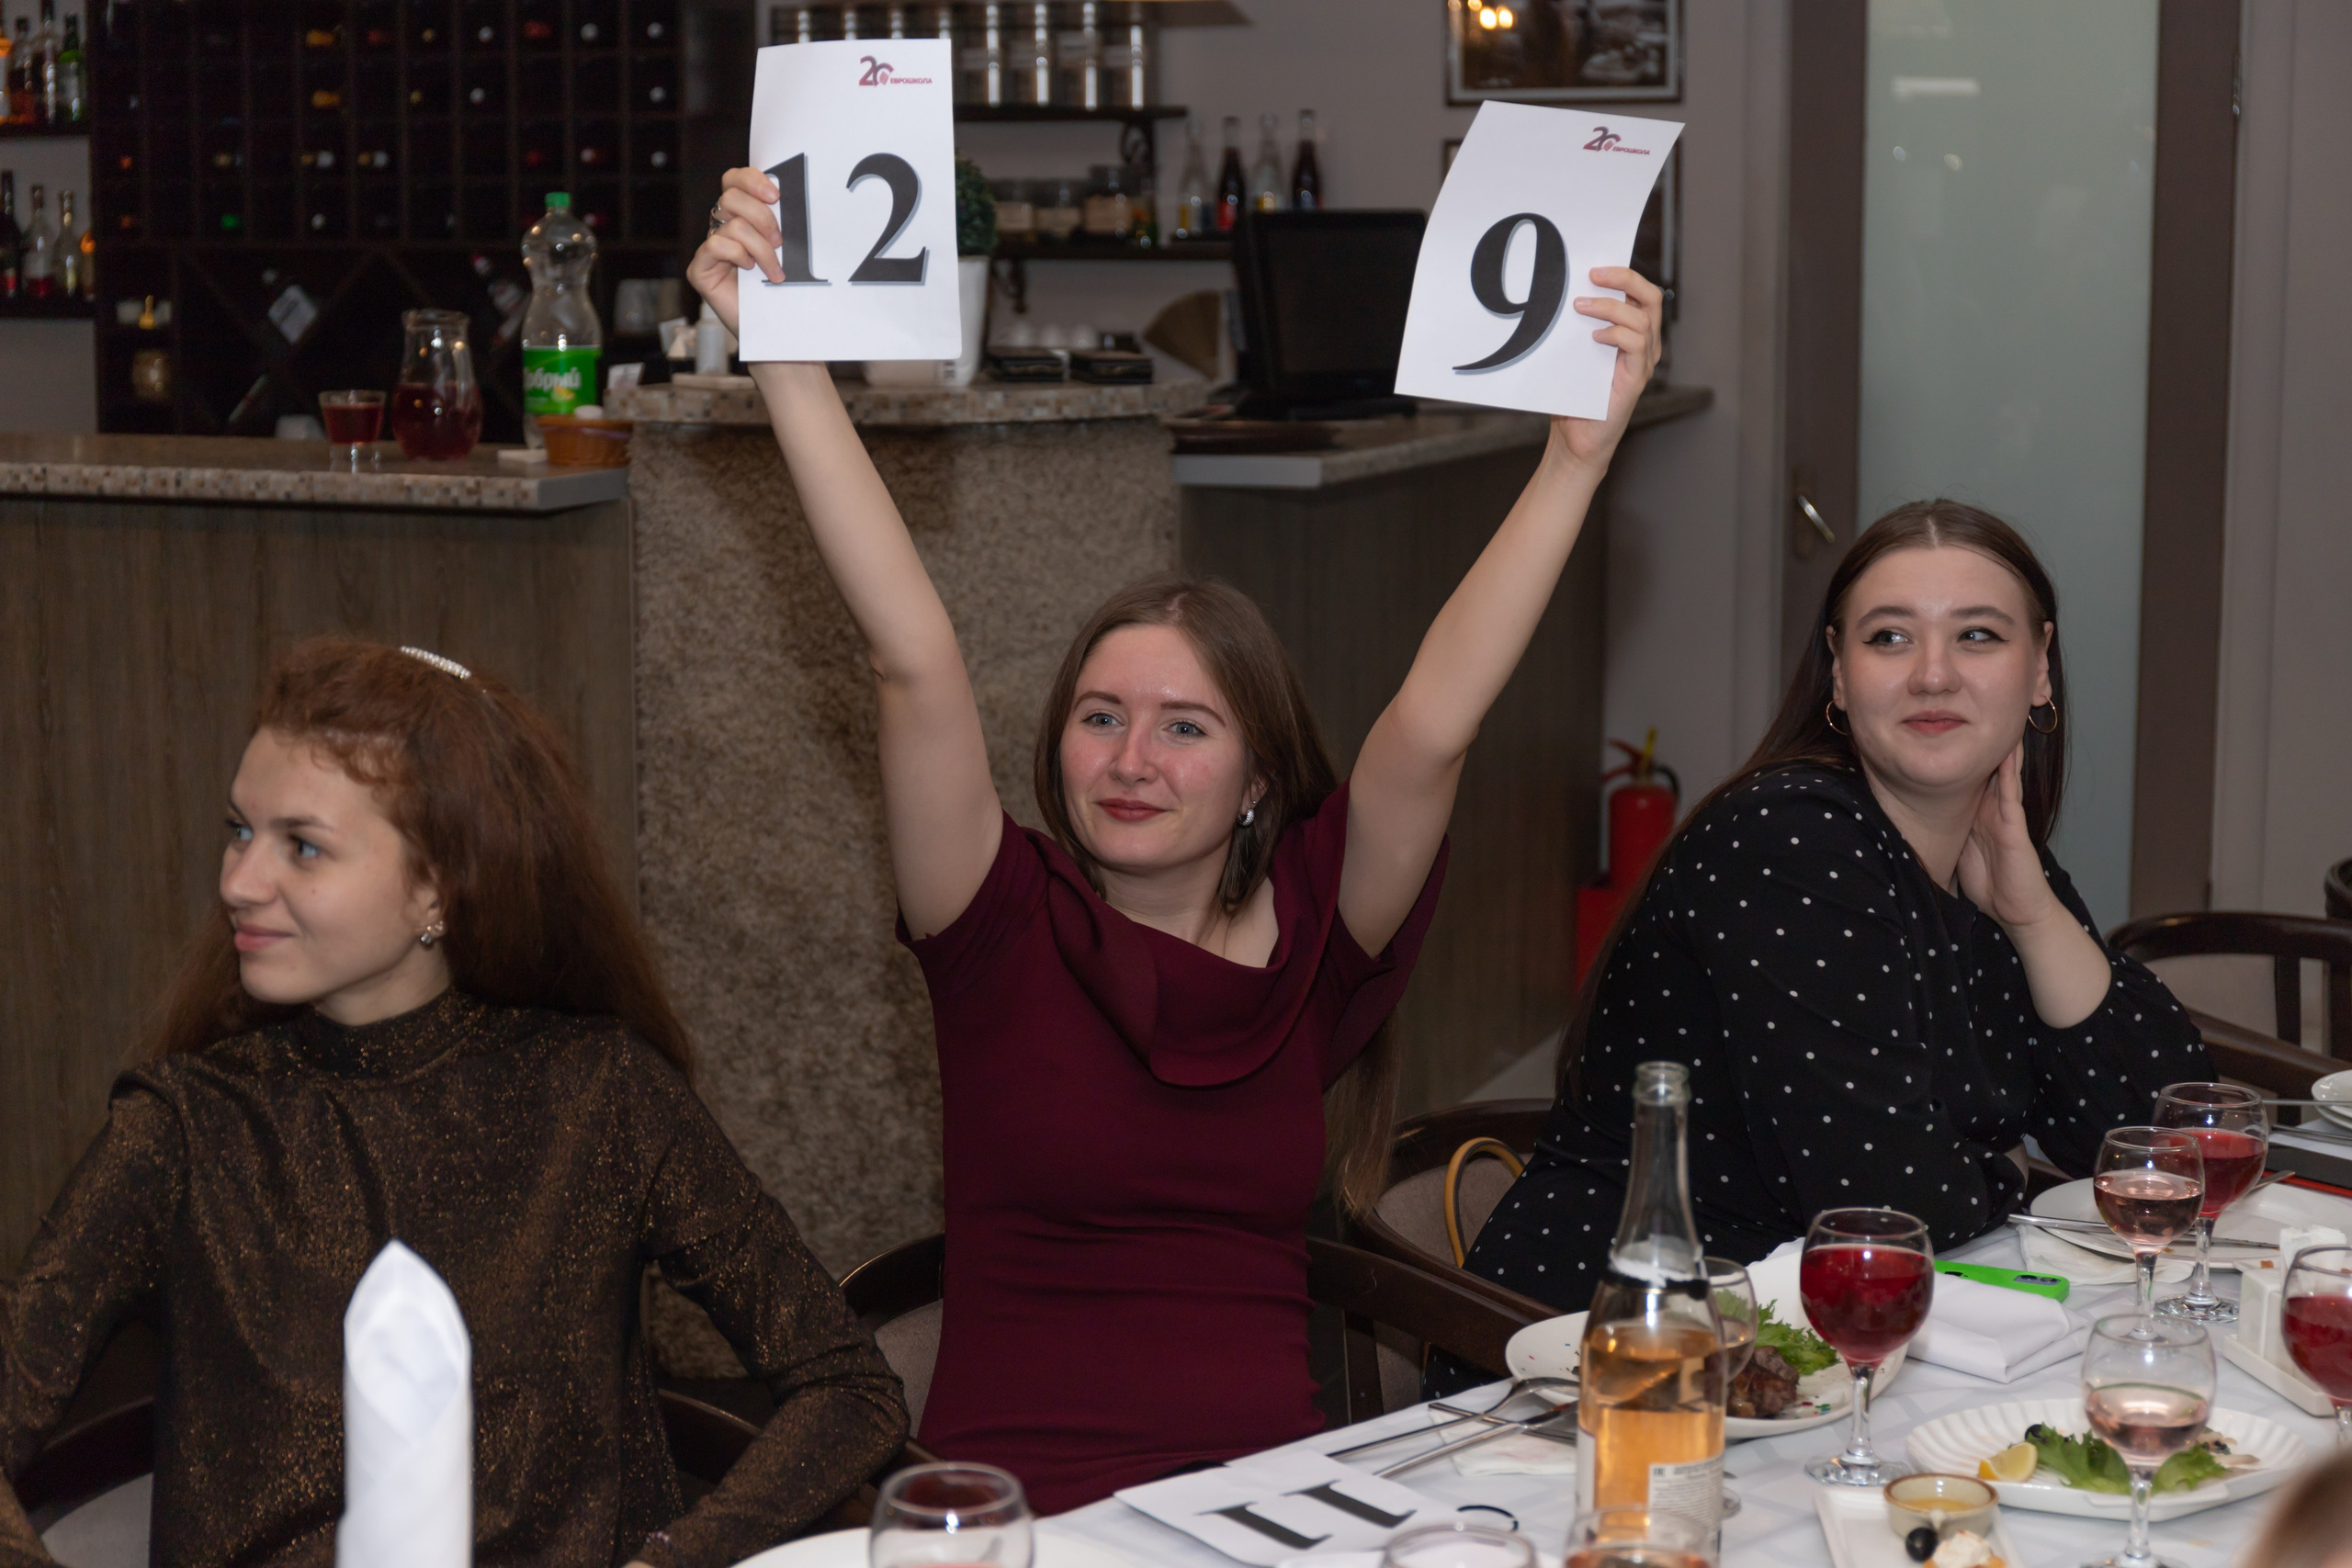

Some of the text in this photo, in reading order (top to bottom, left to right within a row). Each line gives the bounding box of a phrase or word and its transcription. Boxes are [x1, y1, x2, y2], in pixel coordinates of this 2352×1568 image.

[1612, 146, 1650, 155] ЕВРОШКОЛА
[762, 152, 930, 286] 12
[1452, 212, 1570, 375] 9
